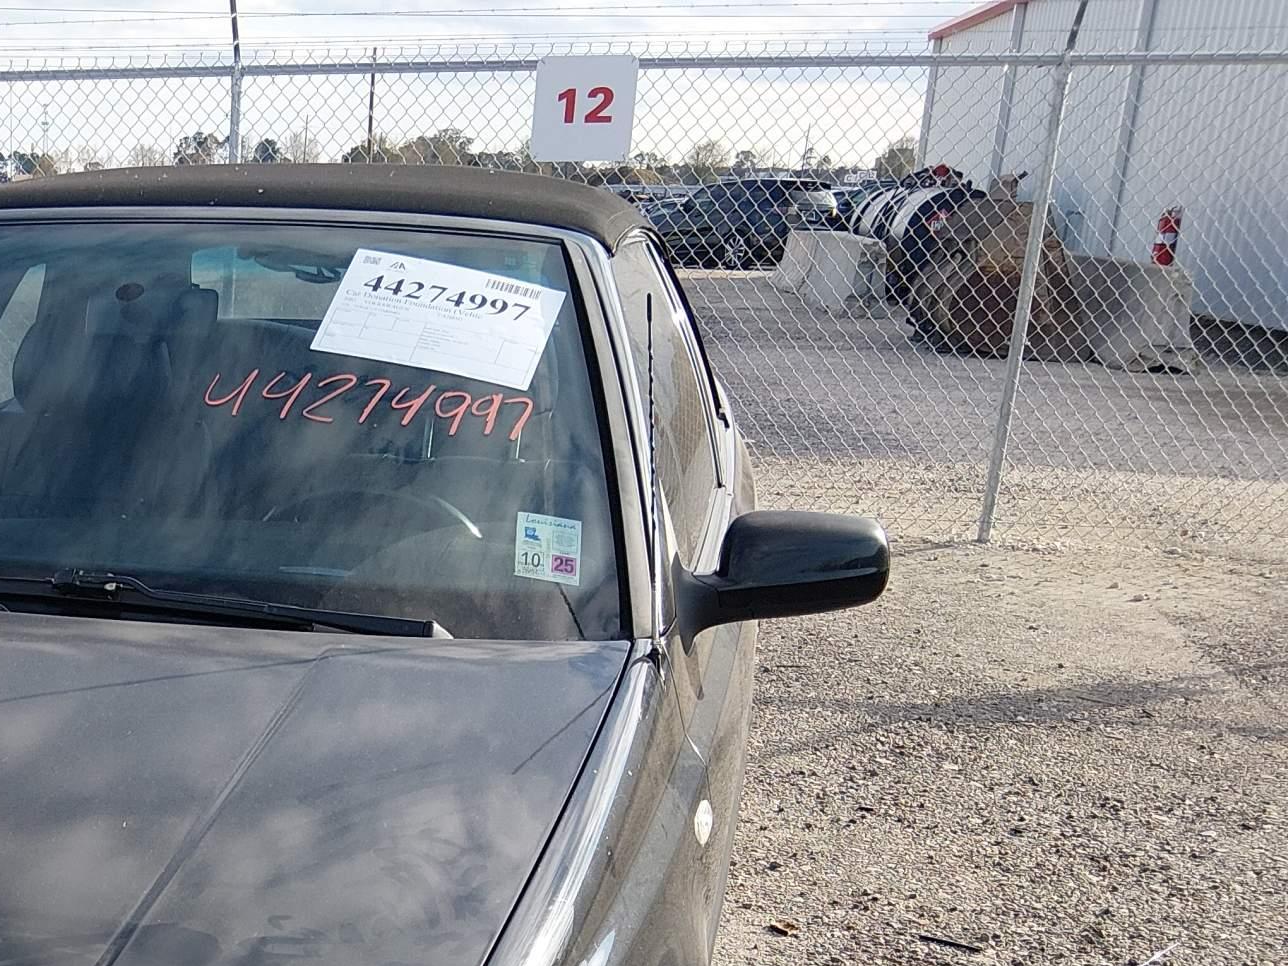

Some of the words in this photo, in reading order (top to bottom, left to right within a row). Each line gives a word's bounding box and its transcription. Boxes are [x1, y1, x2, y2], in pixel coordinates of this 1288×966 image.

[557, 86, 615, 124] 12
[362, 274, 532, 321] 44274997
[203, 368, 535, 441] 44274997
[521, 551, 542, 568] 10
[554, 556, 575, 574] 25
